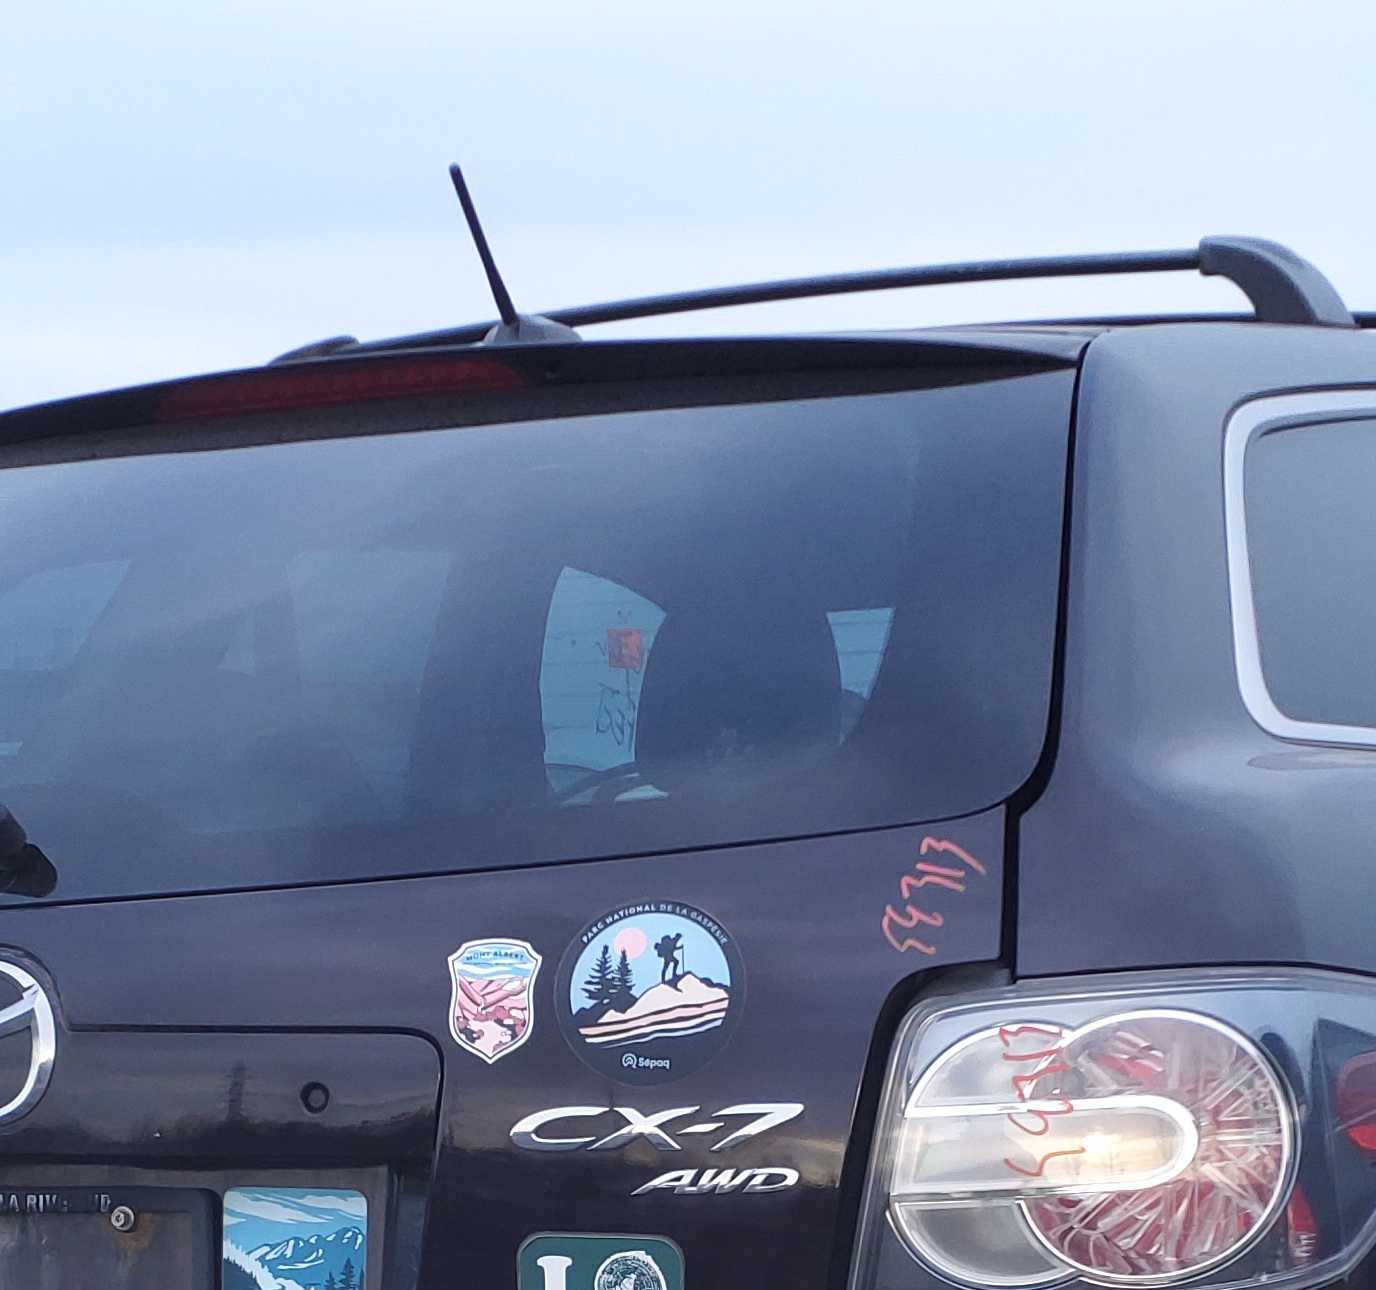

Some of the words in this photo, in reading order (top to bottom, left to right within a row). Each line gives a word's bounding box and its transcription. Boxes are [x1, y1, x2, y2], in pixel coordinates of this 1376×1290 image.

[581, 921, 605, 944] PARC
[605, 904, 656, 925] NATIONAL
[659, 904, 673, 912] DE
[675, 905, 688, 915] LA
[510, 1103, 805, 1151] CX-7
[630, 1168, 800, 1196] AWD
